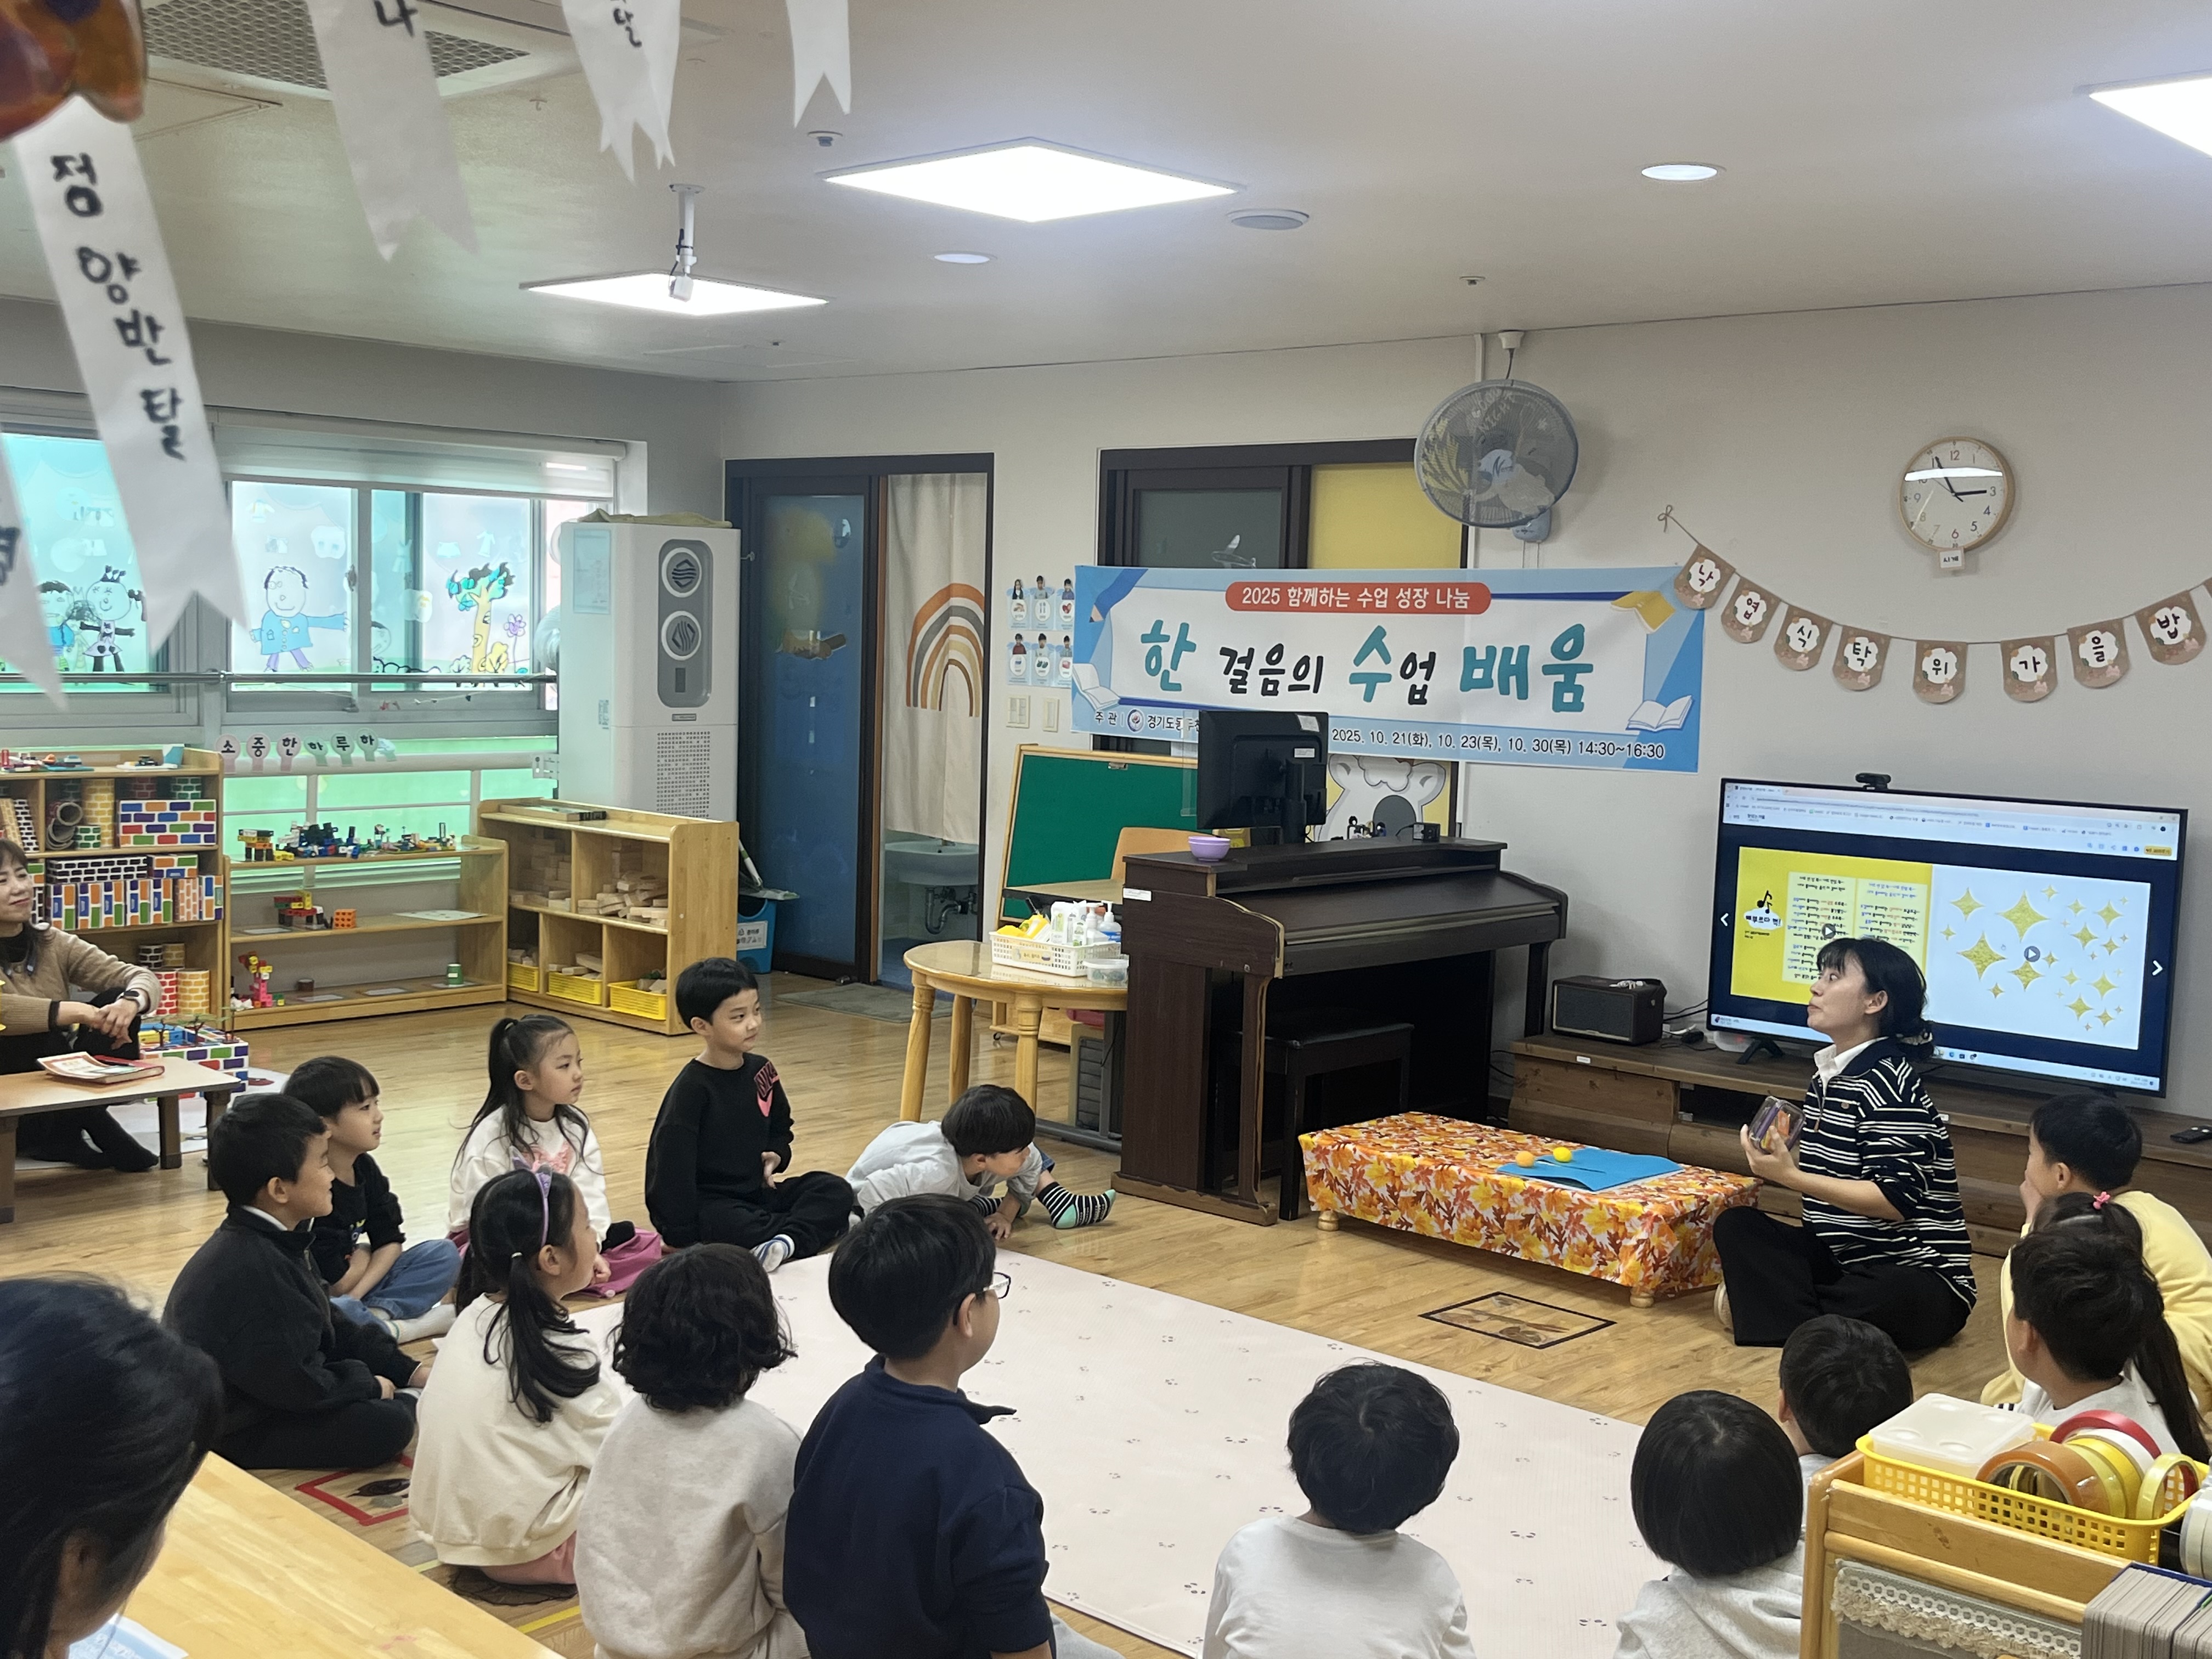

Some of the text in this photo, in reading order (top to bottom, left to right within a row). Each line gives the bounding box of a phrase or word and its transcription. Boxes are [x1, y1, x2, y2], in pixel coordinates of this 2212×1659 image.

[1950, 450, 1960, 461] 12
[1990, 486, 1996, 496] 3
[1914, 493, 1921, 503] 9
[1983, 505, 1991, 516] 4
[1970, 521, 1978, 532] 5
[1951, 528, 1959, 539] 6
[1243, 588, 1470, 608] 2025 함께하는 수업 성장 나눔
[1141, 619, 1593, 713] 한 걸음의 수업 배움
[1332, 729, 1664, 759] 2025. 10. 21(화), 10. 23(목), 10. 30(목) 14:30~16:30
